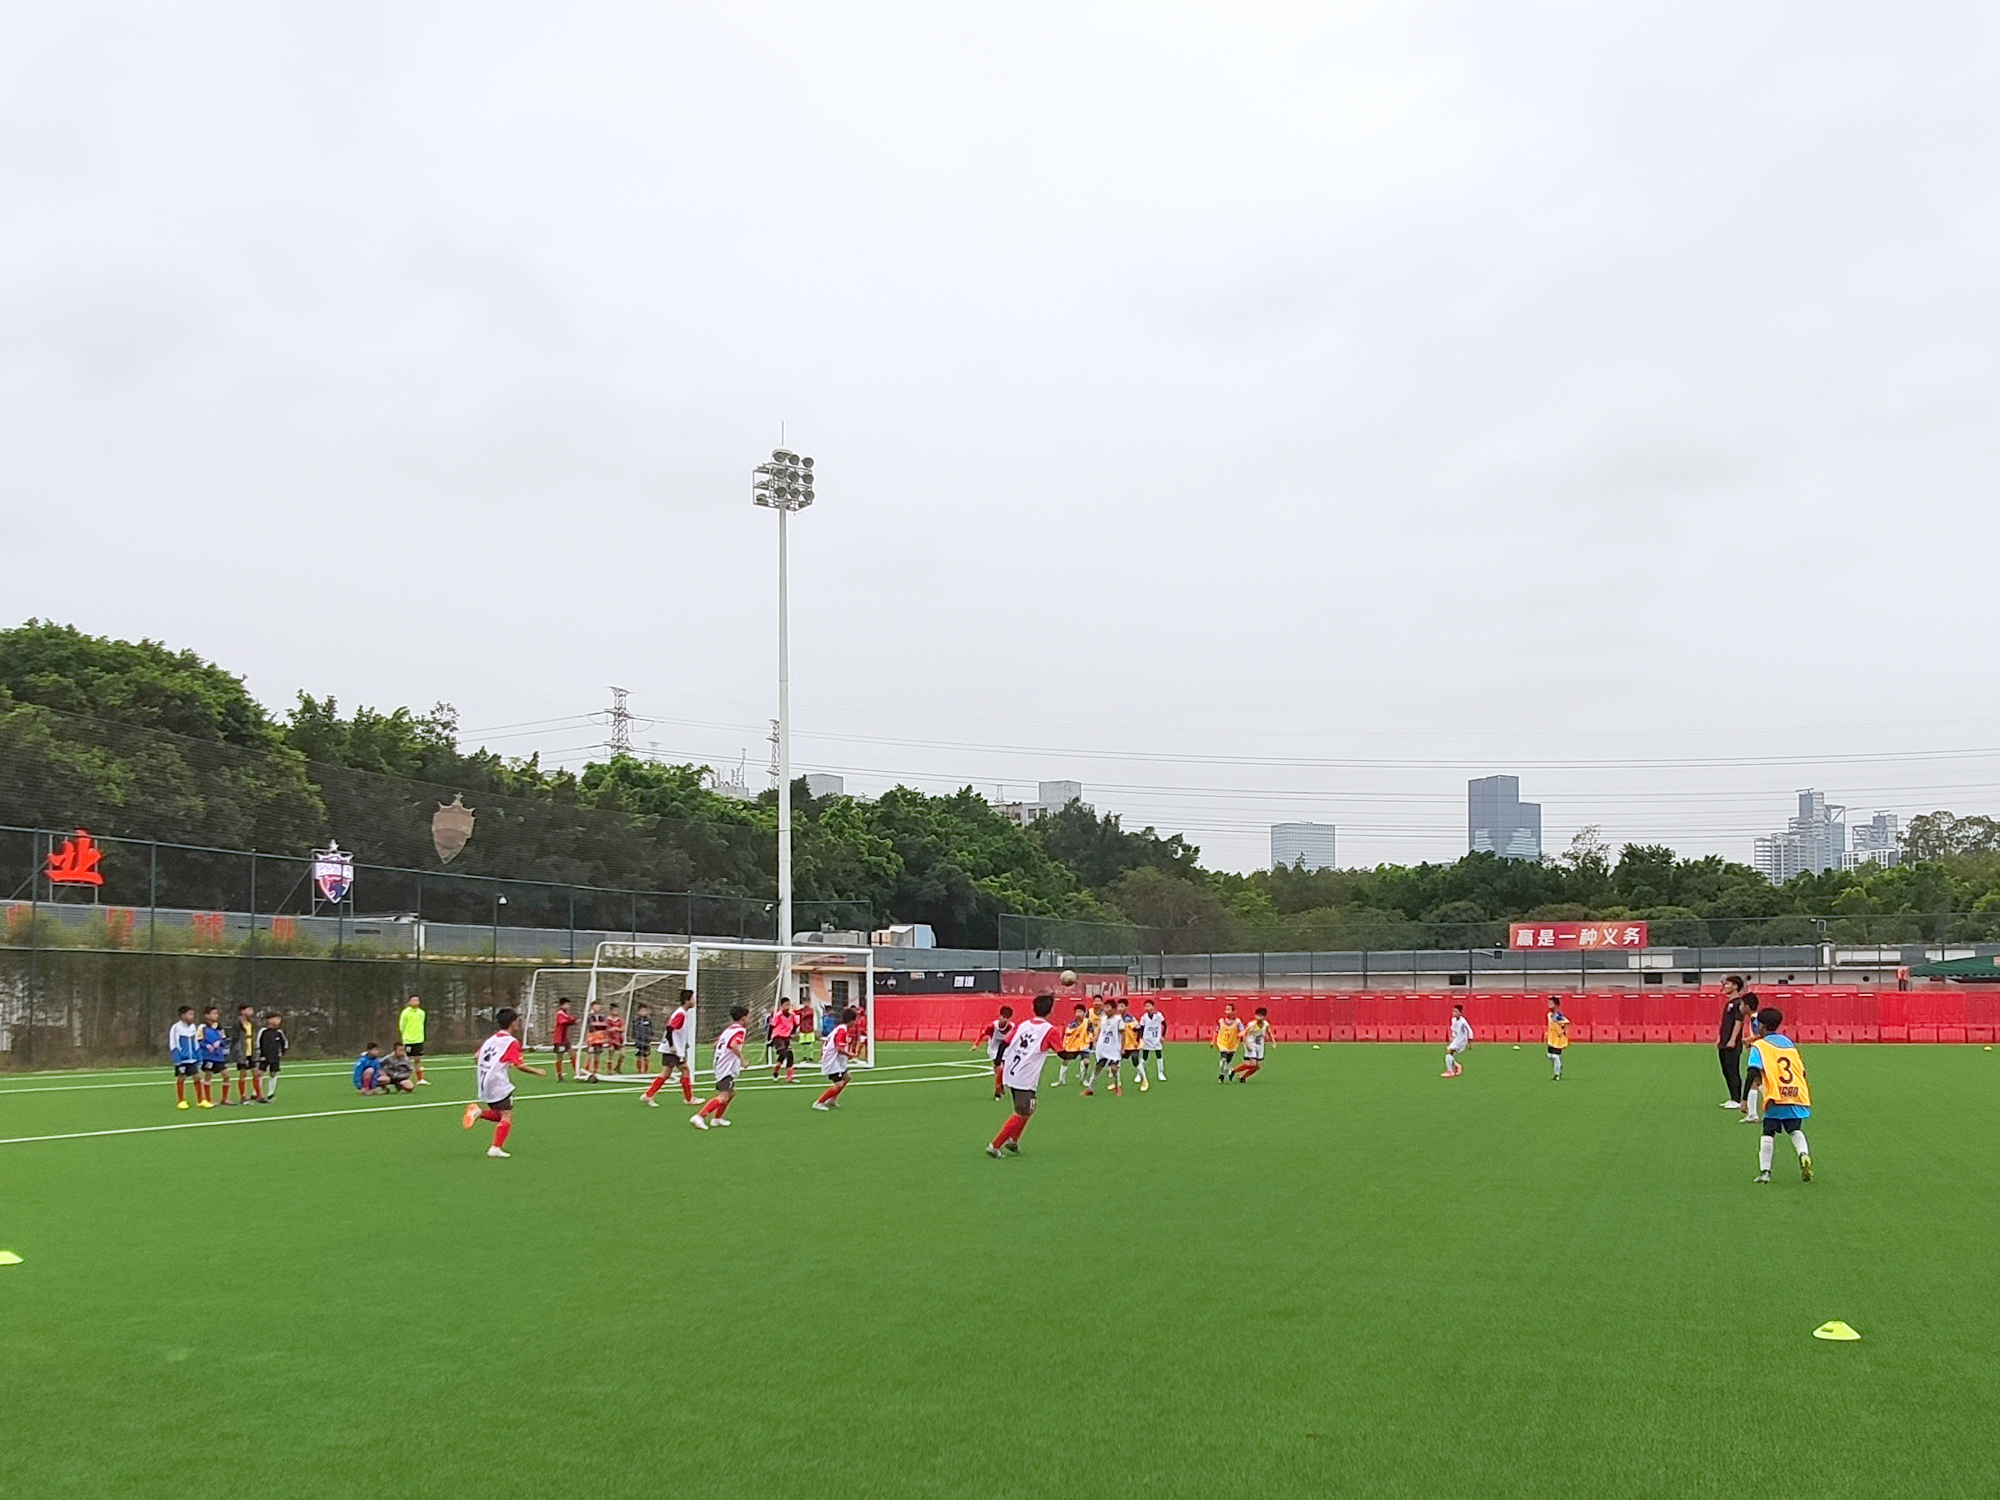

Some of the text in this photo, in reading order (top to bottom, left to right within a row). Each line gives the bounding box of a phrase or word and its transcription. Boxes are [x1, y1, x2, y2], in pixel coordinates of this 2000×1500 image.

[1516, 927, 1641, 947] 赢是一种义务
[1777, 1056, 1793, 1084] 3
